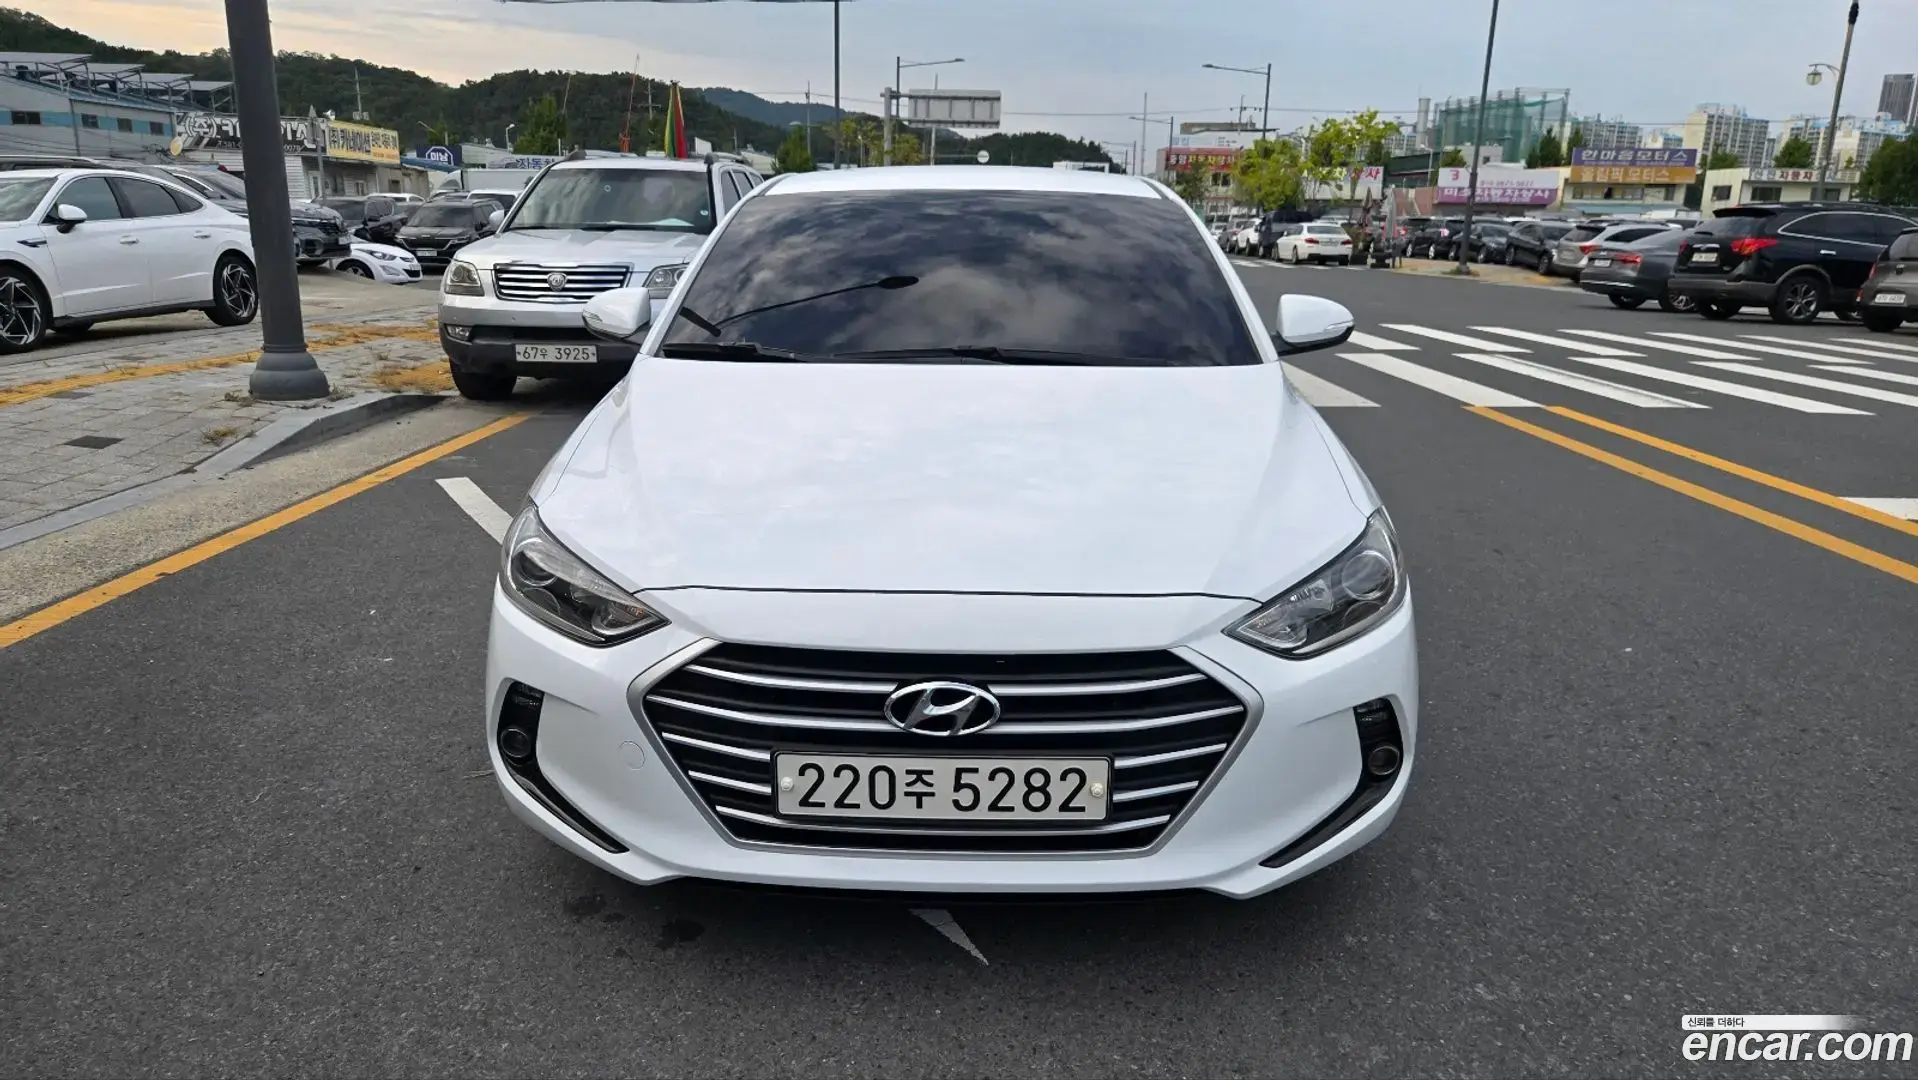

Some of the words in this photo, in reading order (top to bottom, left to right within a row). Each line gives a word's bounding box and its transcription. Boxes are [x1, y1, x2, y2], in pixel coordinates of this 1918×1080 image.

[522, 346, 548, 360] 67우
[554, 347, 590, 361] 3925
[798, 762, 936, 810] 220주
[951, 767, 1088, 813] 5282
